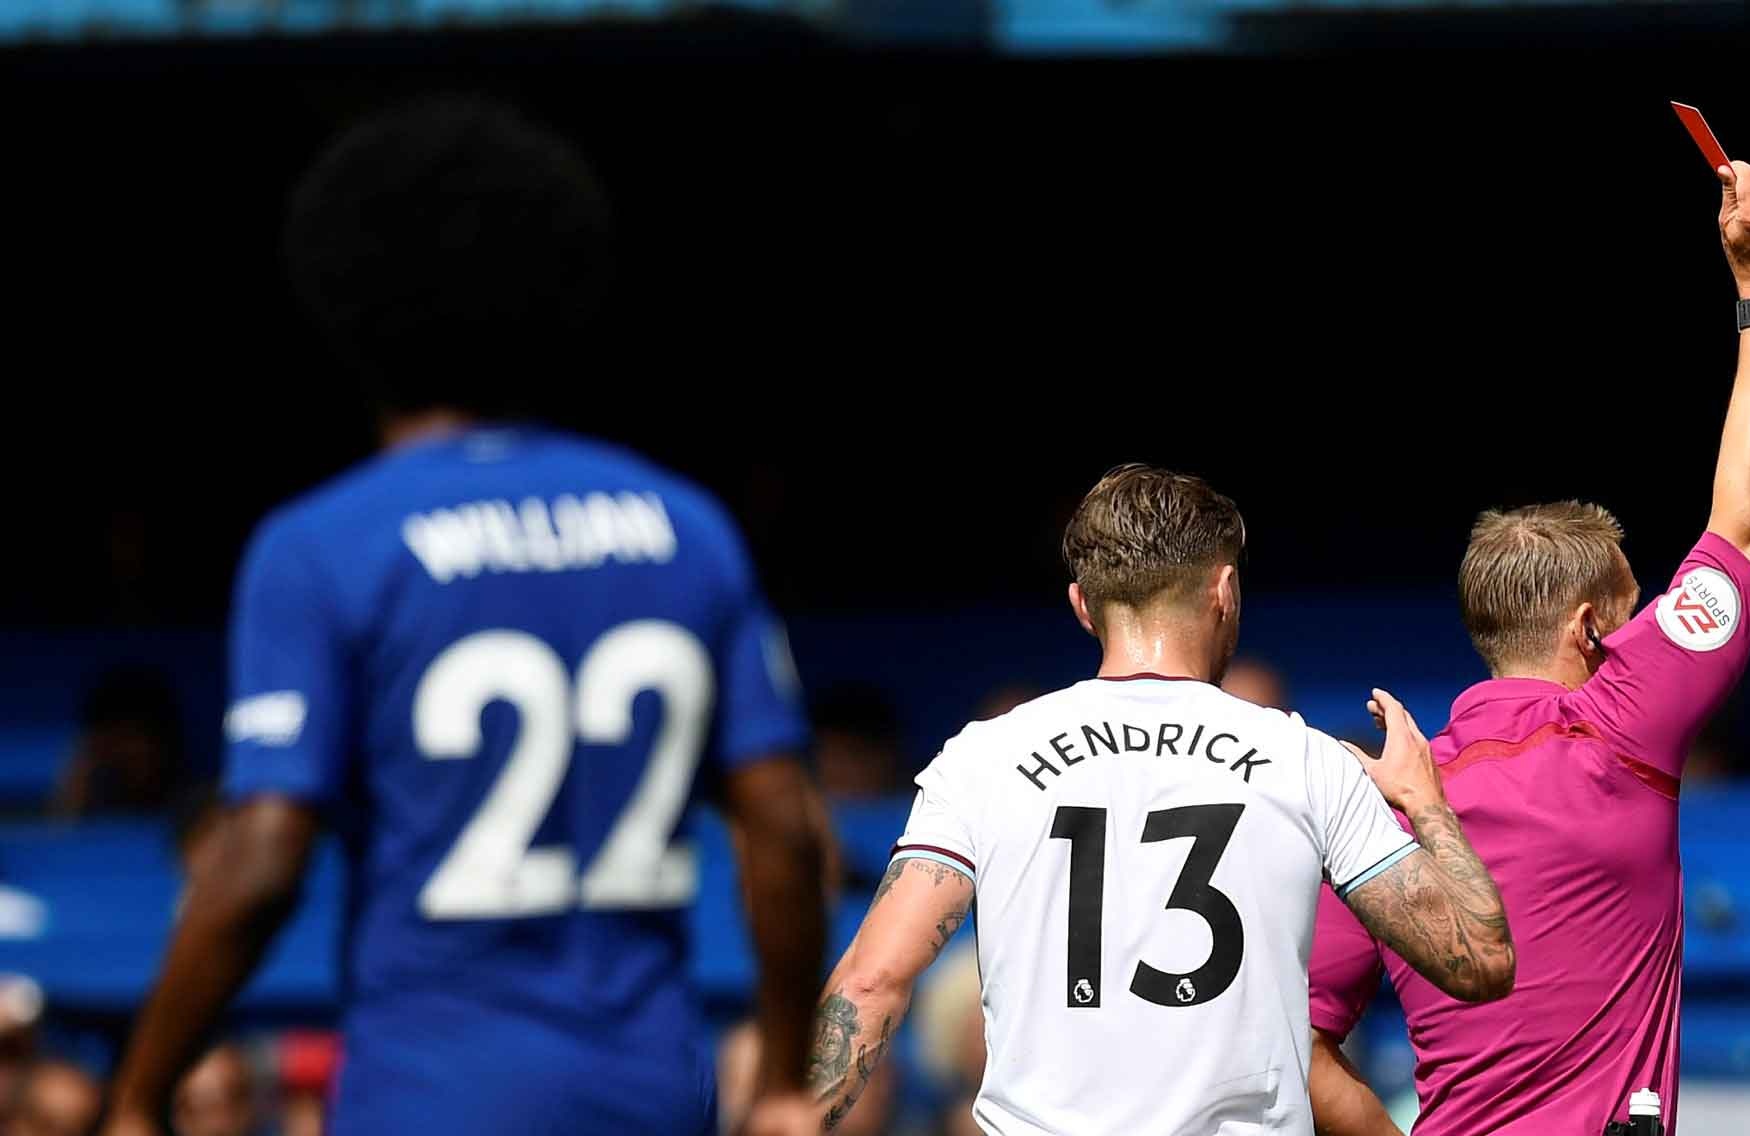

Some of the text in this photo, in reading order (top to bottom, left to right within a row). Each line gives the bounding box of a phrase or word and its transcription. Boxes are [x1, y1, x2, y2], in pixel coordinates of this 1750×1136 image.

[402, 490, 677, 583] WILLIAN
[1686, 576, 1731, 627] SPORTS
[412, 619, 710, 919] 22
[1016, 721, 1273, 791] HENDRICK
[1049, 803, 1246, 1009] 13
